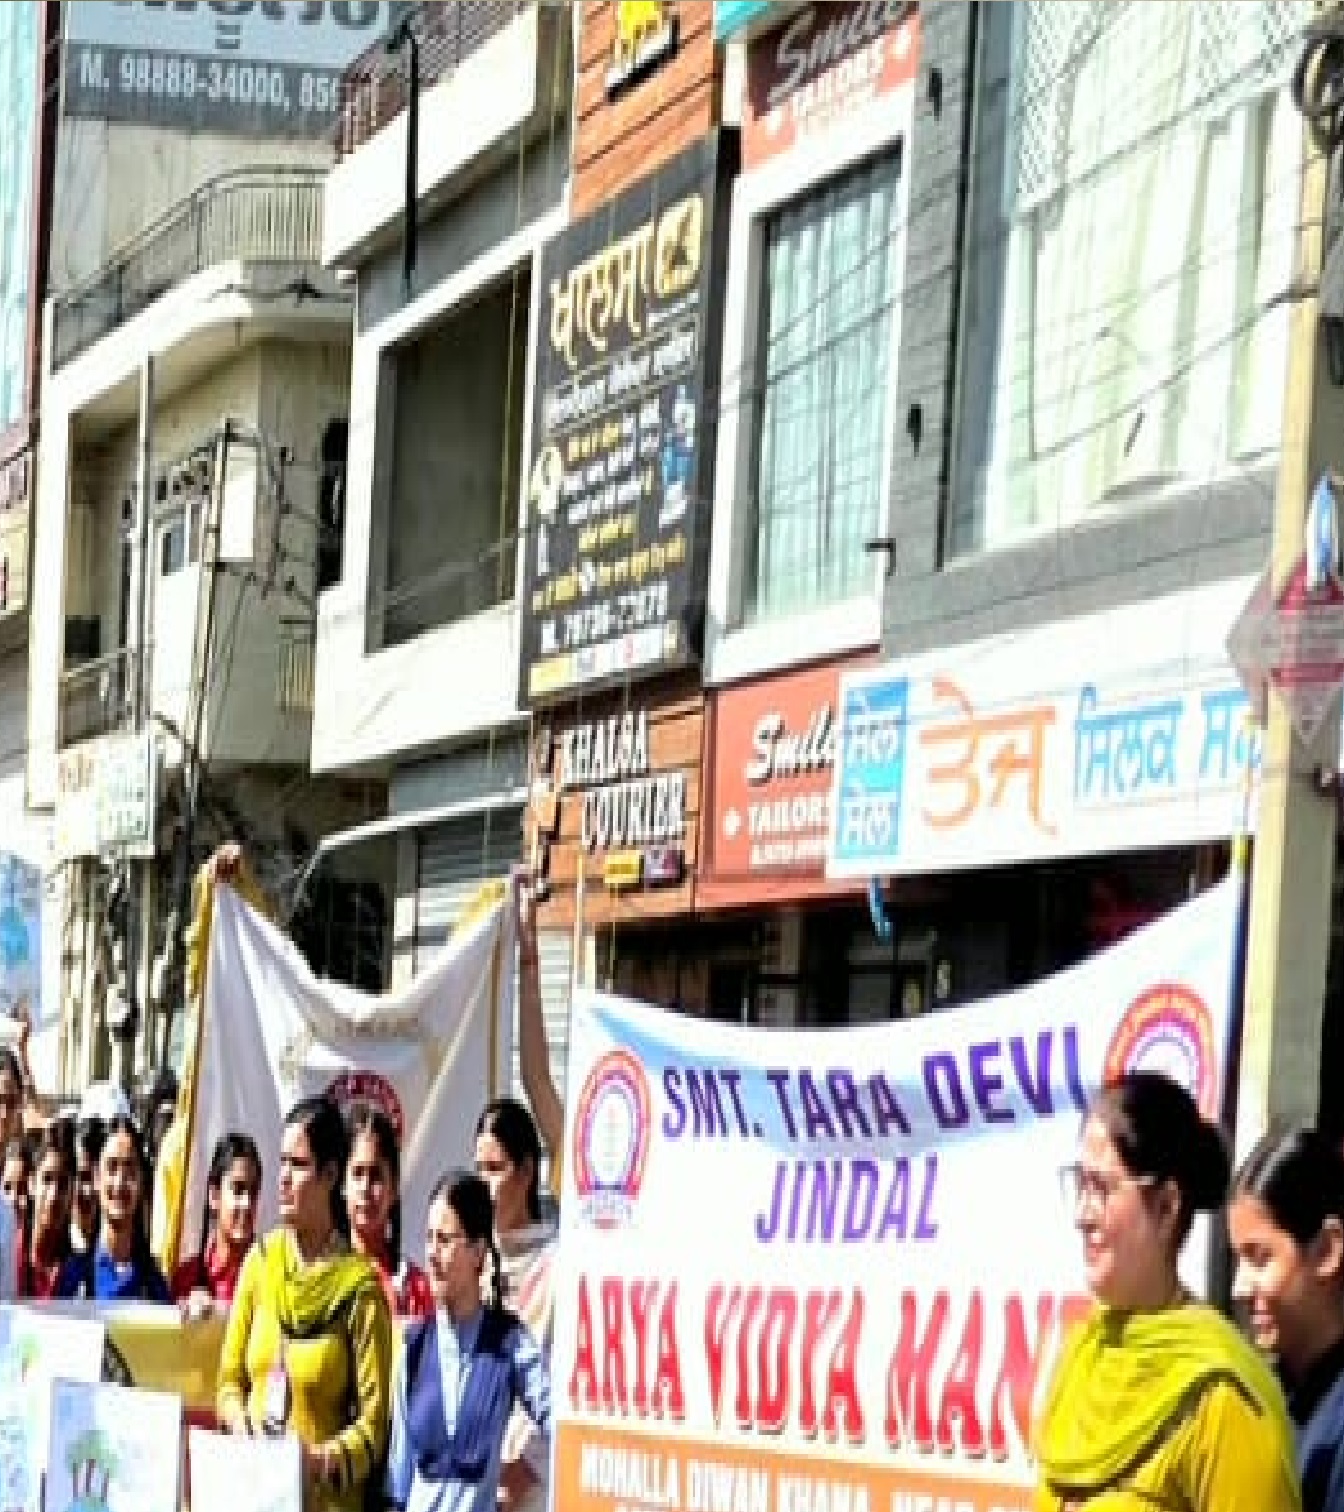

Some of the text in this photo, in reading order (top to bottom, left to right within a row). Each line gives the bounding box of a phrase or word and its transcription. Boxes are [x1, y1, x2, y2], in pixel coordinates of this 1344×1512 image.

[80, 50, 110, 88] M.
[560, 710, 649, 786] KHALSA
[919, 675, 1058, 836] ਤੇਜ
[580, 771, 685, 848] COURIER
[662, 1024, 1088, 1141] SMT. TARA DEVI
[755, 1151, 941, 1247] JINDAL
[568, 1273, 1096, 1462] ARYA VIDYA MAN
[579, 1442, 681, 1508] MOHALLA
